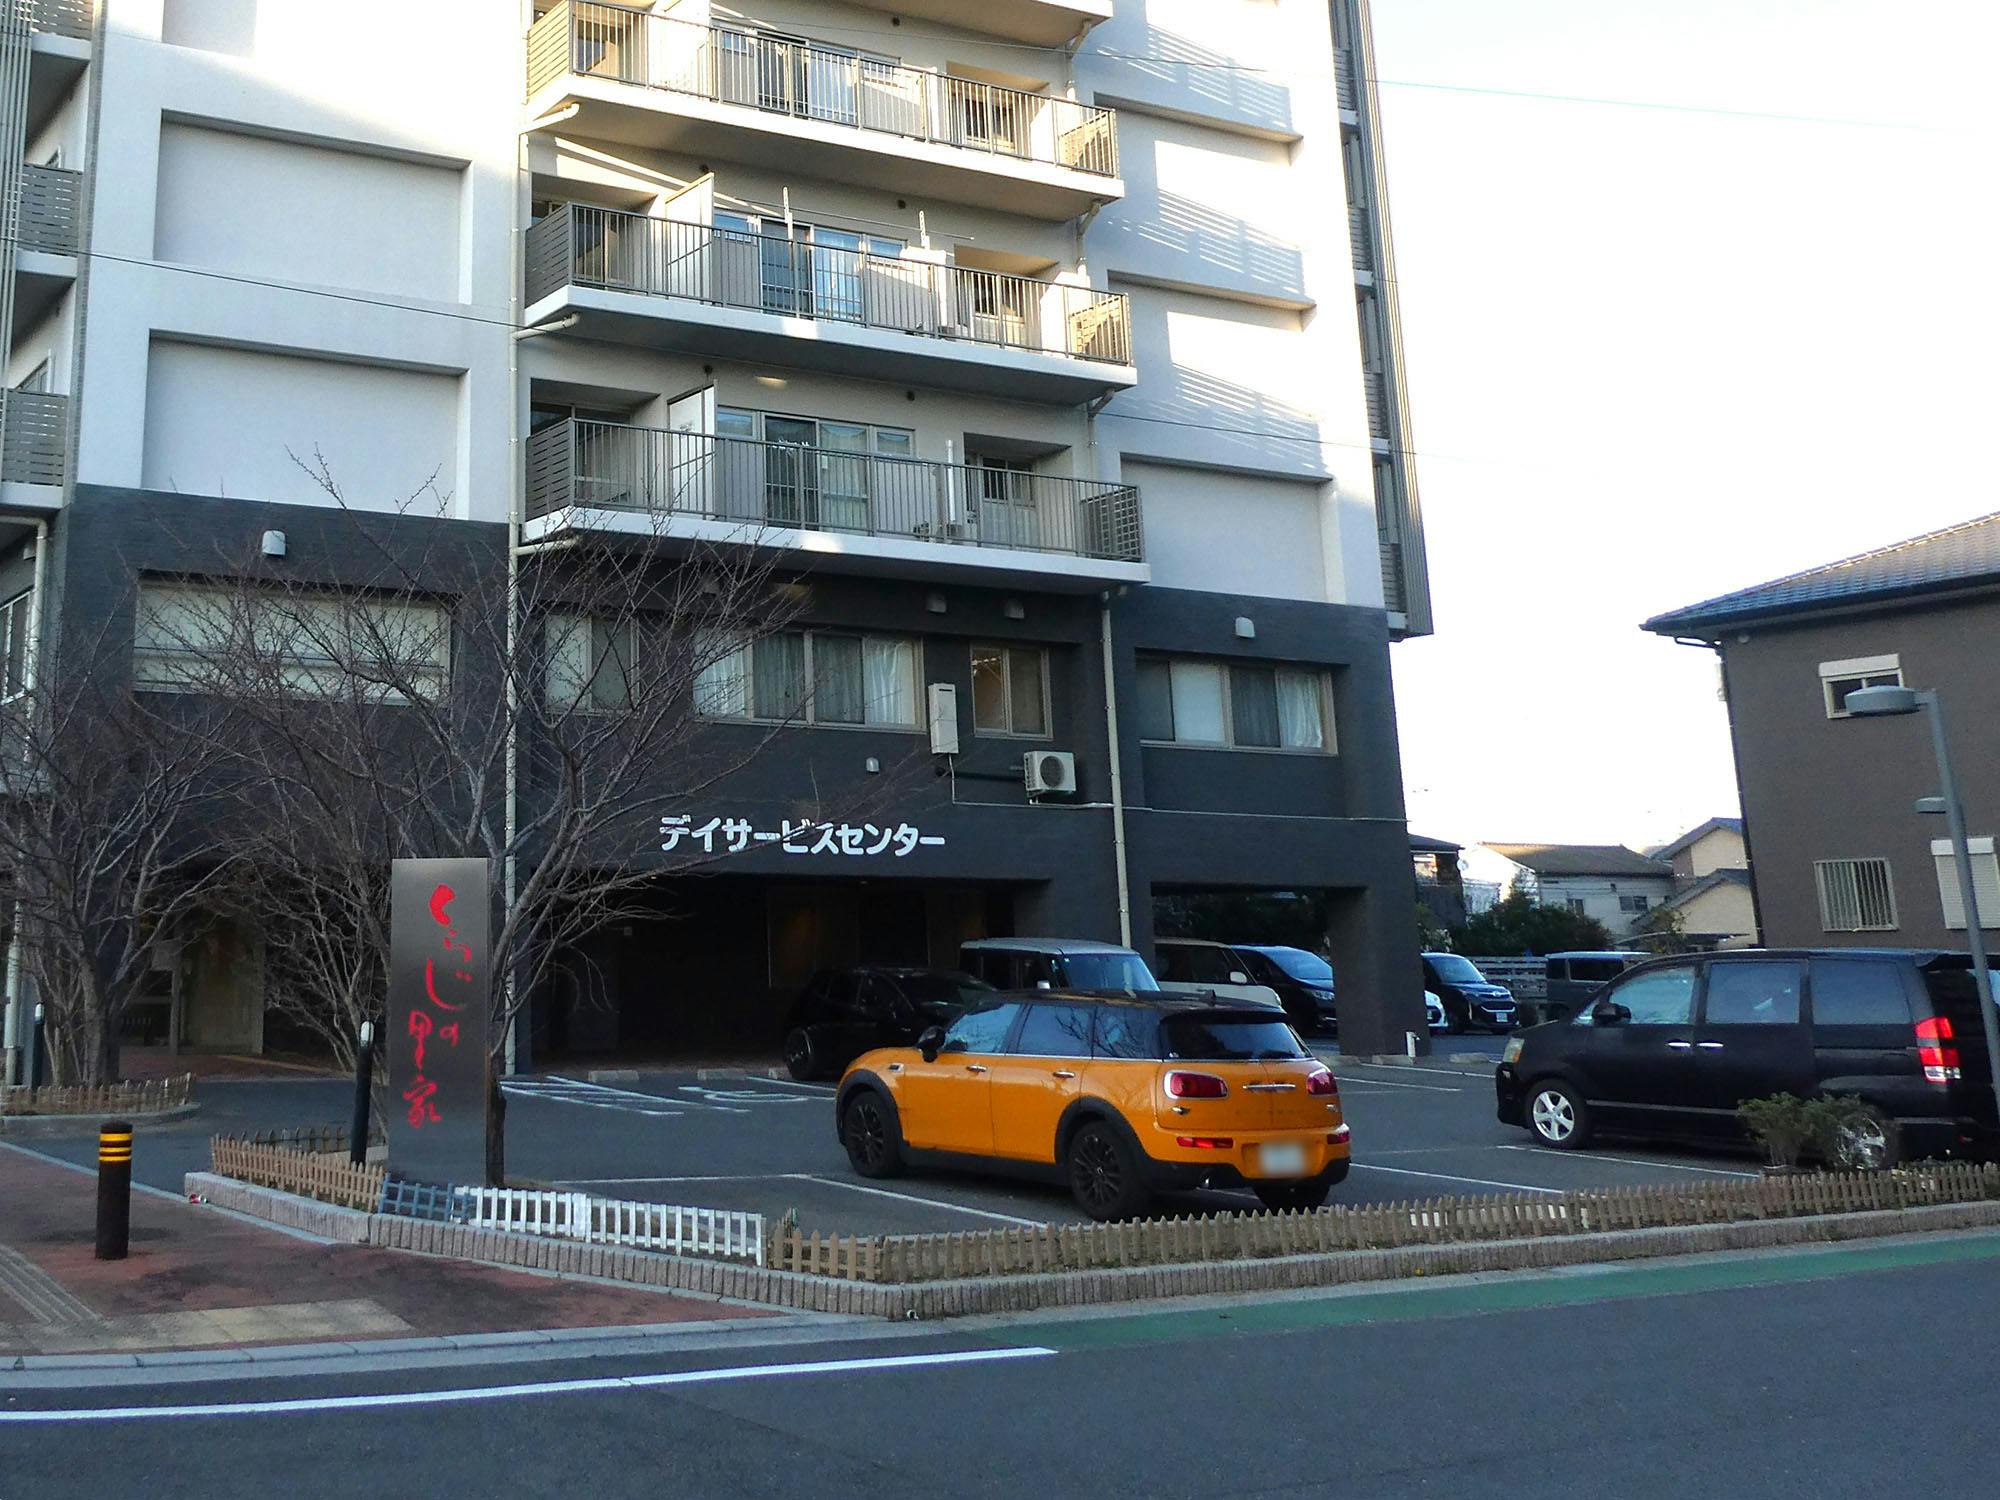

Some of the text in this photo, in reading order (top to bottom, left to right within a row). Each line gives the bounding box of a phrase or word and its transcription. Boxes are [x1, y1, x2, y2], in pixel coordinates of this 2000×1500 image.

[659, 814, 946, 856] デイサービスセンター
